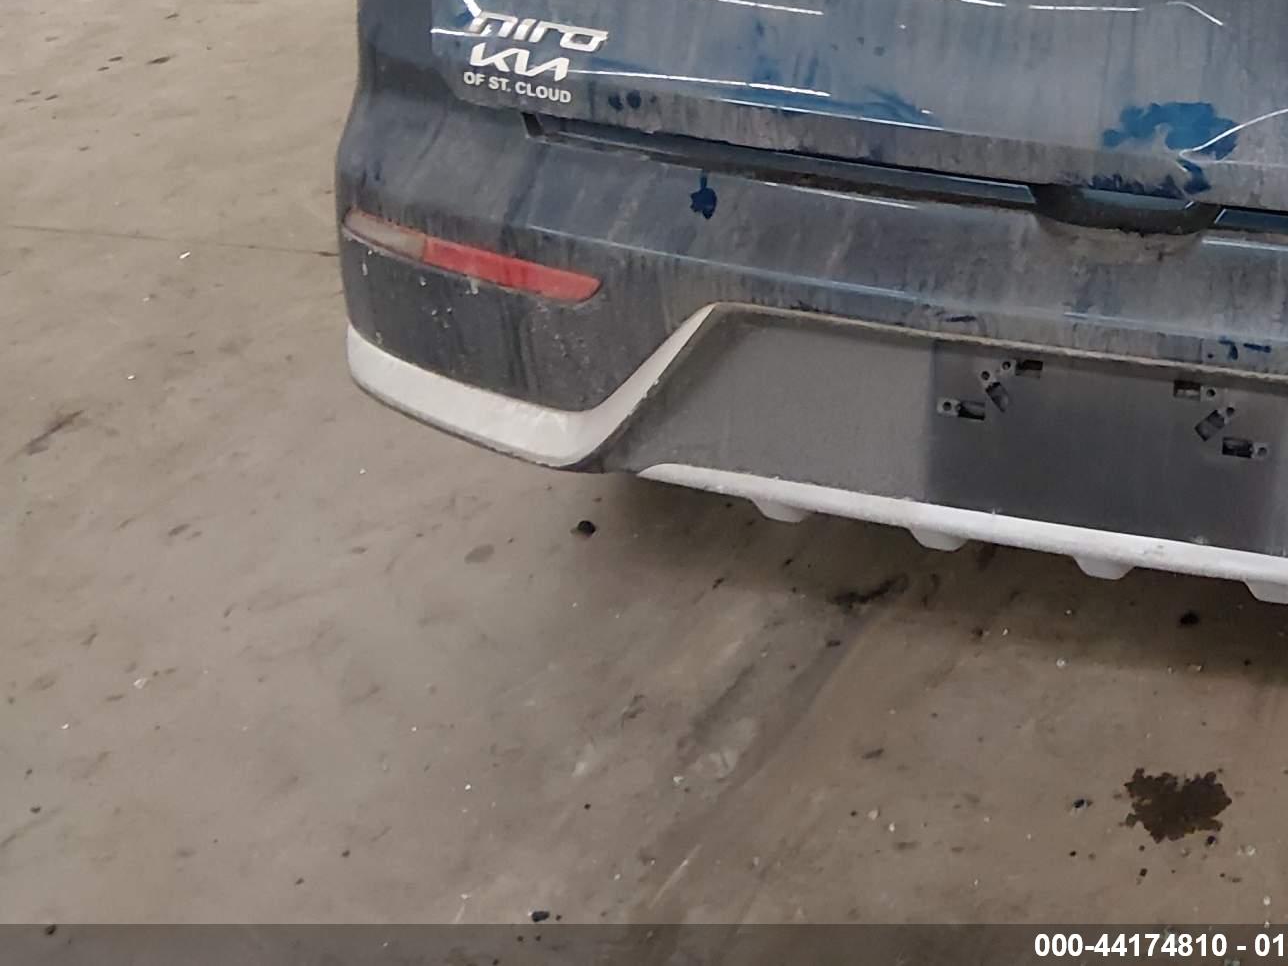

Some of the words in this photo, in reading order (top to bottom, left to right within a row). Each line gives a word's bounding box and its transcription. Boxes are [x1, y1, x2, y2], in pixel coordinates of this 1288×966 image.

[469, 42, 570, 82] KIA
[463, 71, 486, 86] OF
[488, 75, 511, 93] ST.
[515, 81, 572, 103] CLOUD
